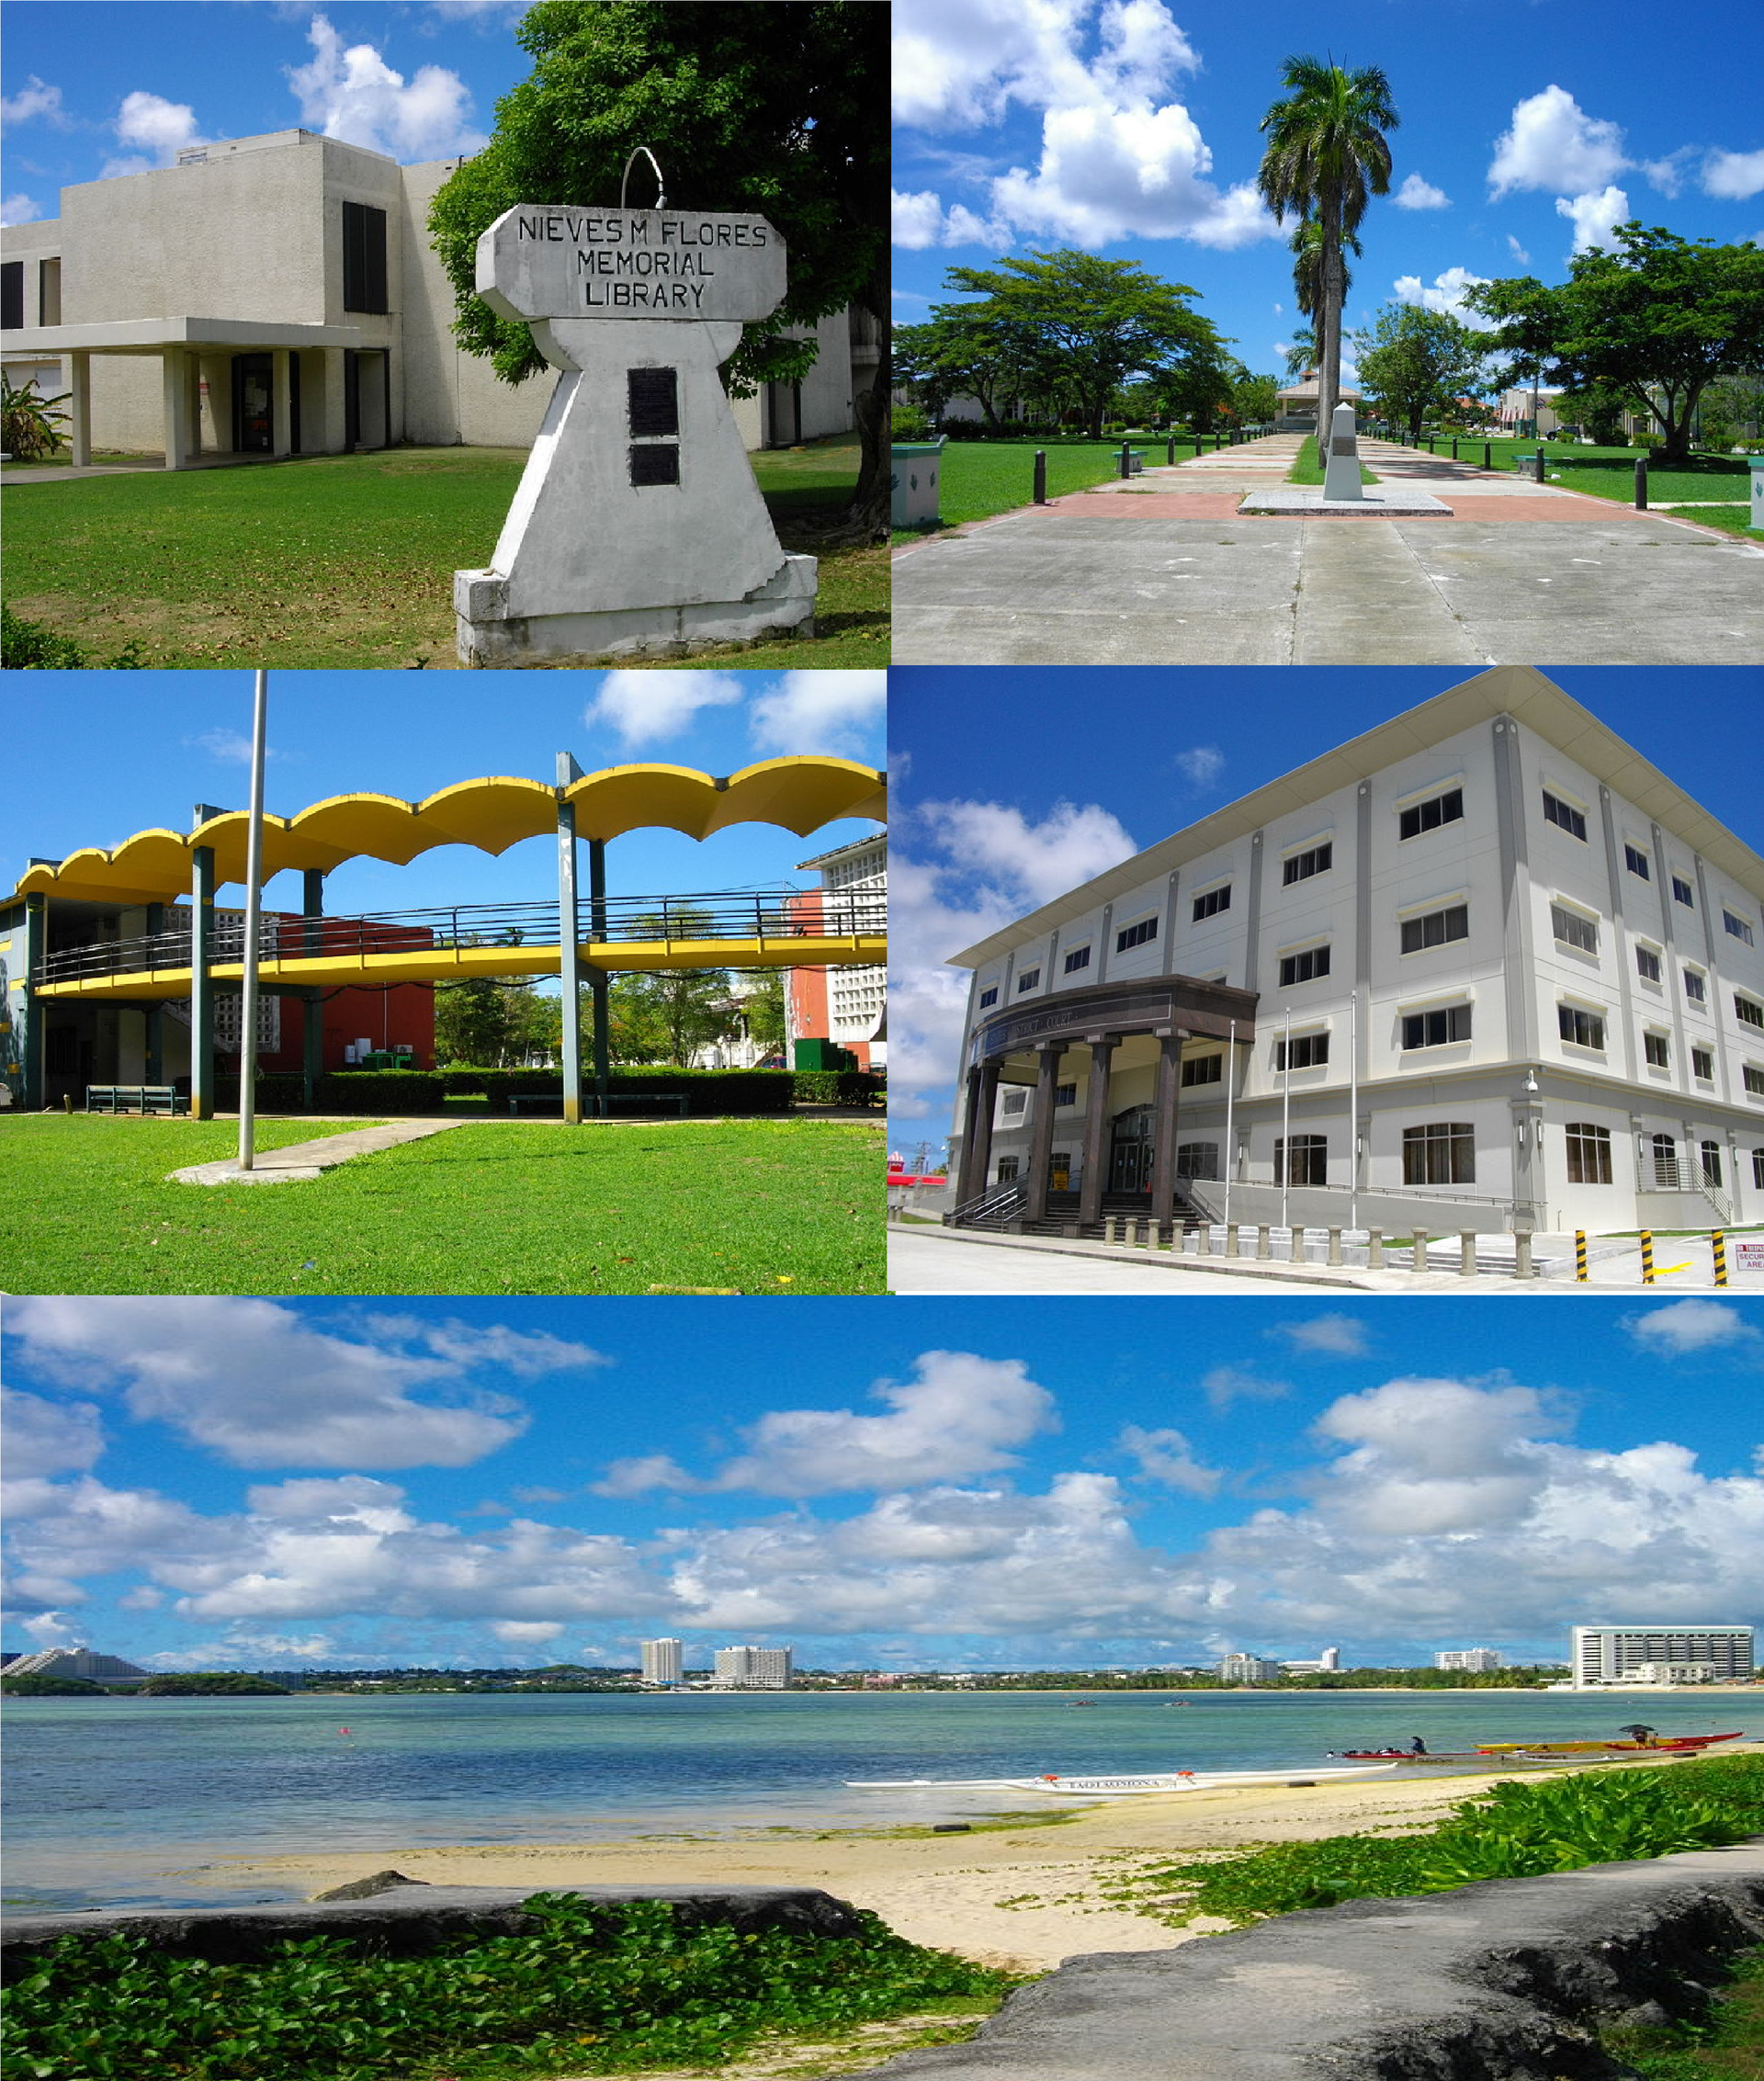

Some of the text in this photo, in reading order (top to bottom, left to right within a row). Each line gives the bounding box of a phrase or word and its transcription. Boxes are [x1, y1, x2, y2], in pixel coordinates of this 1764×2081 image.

[519, 216, 767, 247] NIEVES M FLORES
[578, 250, 715, 277] MEMORIAL
[585, 282, 705, 308] LIBRARY
[1012, 1019, 1039, 1038] STRICT
